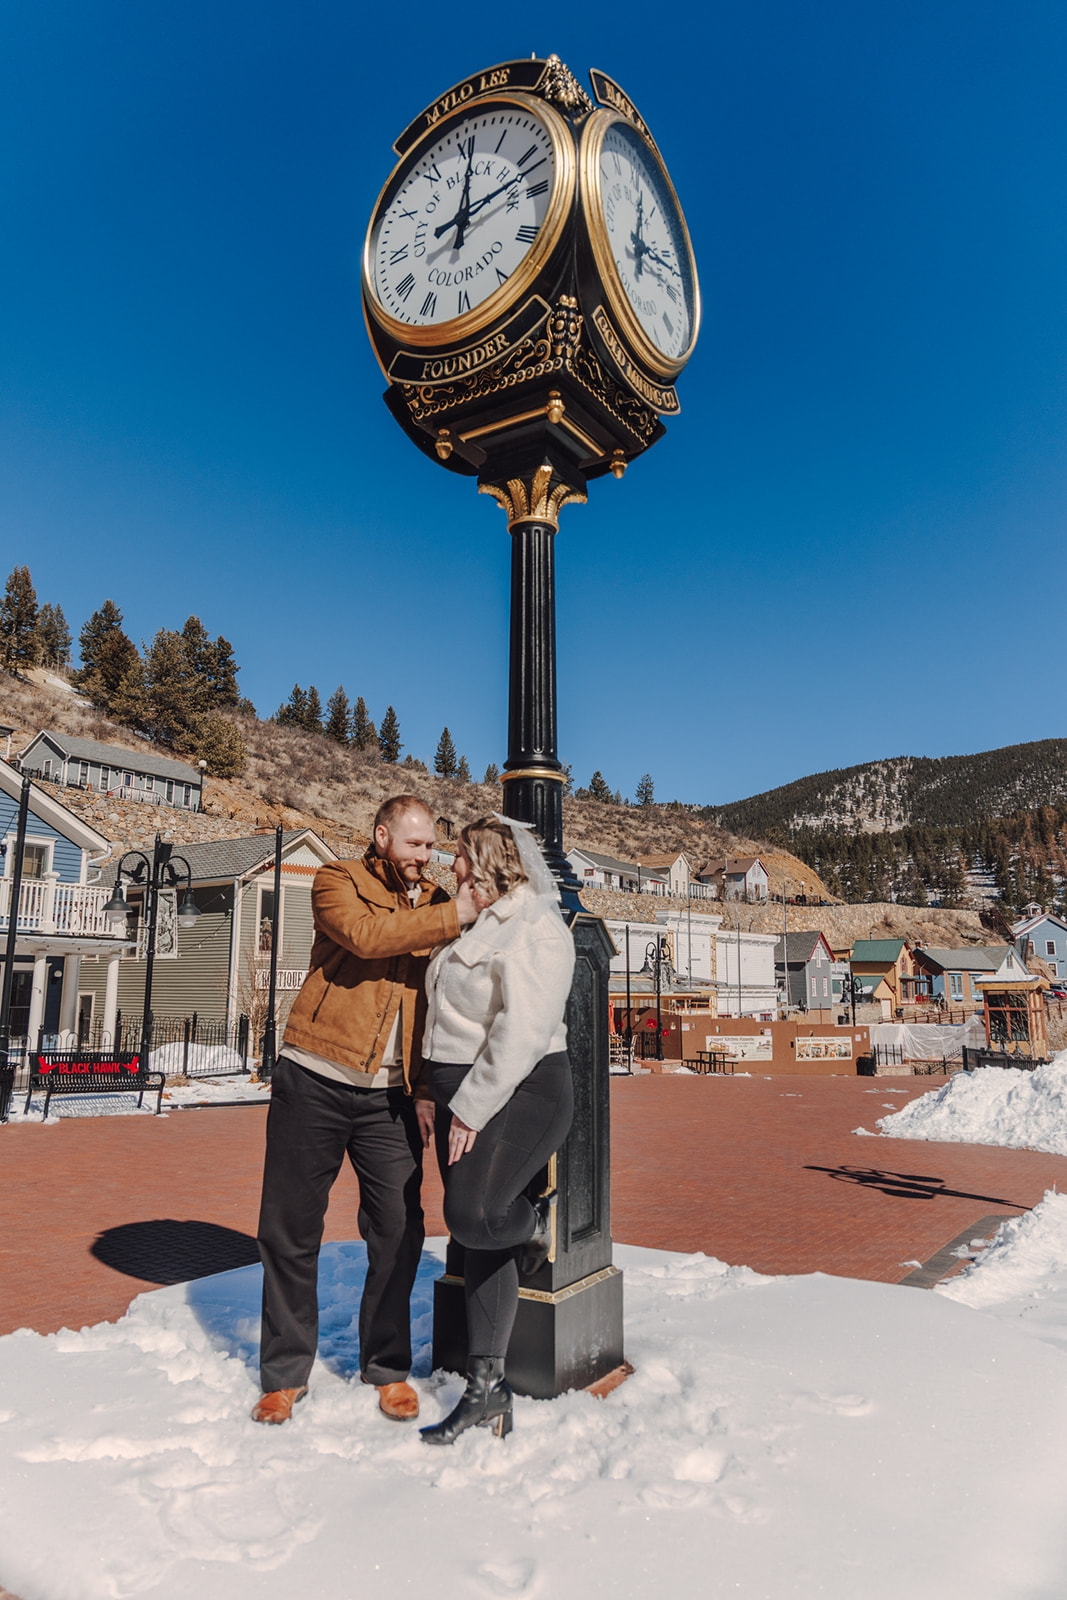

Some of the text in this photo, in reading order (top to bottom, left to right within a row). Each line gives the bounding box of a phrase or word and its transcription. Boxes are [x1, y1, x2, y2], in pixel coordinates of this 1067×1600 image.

[425, 67, 511, 126] MYLO LEE
[414, 160, 520, 258] CITY OF BLCK HWK
[428, 241, 503, 287] COLORADO
[421, 333, 510, 379] FOUNDER
[58, 1062, 122, 1074] BLACK HAWK
